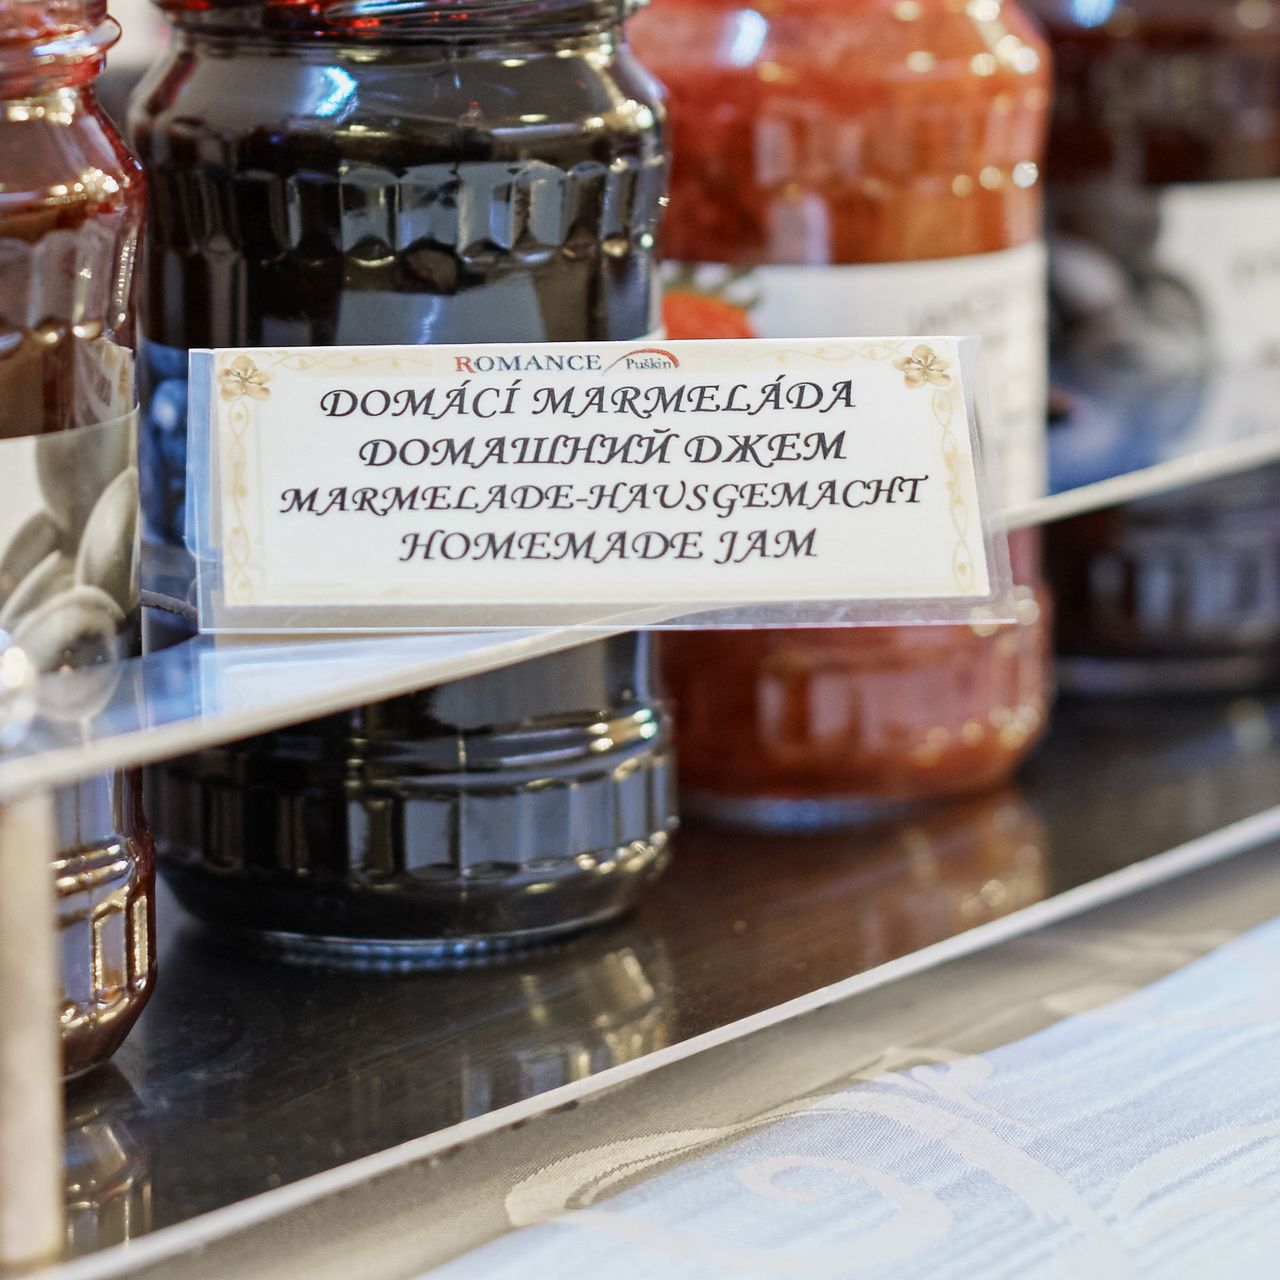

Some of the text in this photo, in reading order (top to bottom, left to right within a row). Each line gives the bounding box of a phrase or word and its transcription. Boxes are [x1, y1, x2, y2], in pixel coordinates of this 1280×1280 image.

[455, 354, 672, 374] ROMANCE Puškin
[320, 374, 856, 420] DOMÁCÍ MARMELÁDA
[279, 474, 929, 519] MARMELADE-HAUSGEMACHT
[399, 527, 818, 565] HOMEMADE JAM
